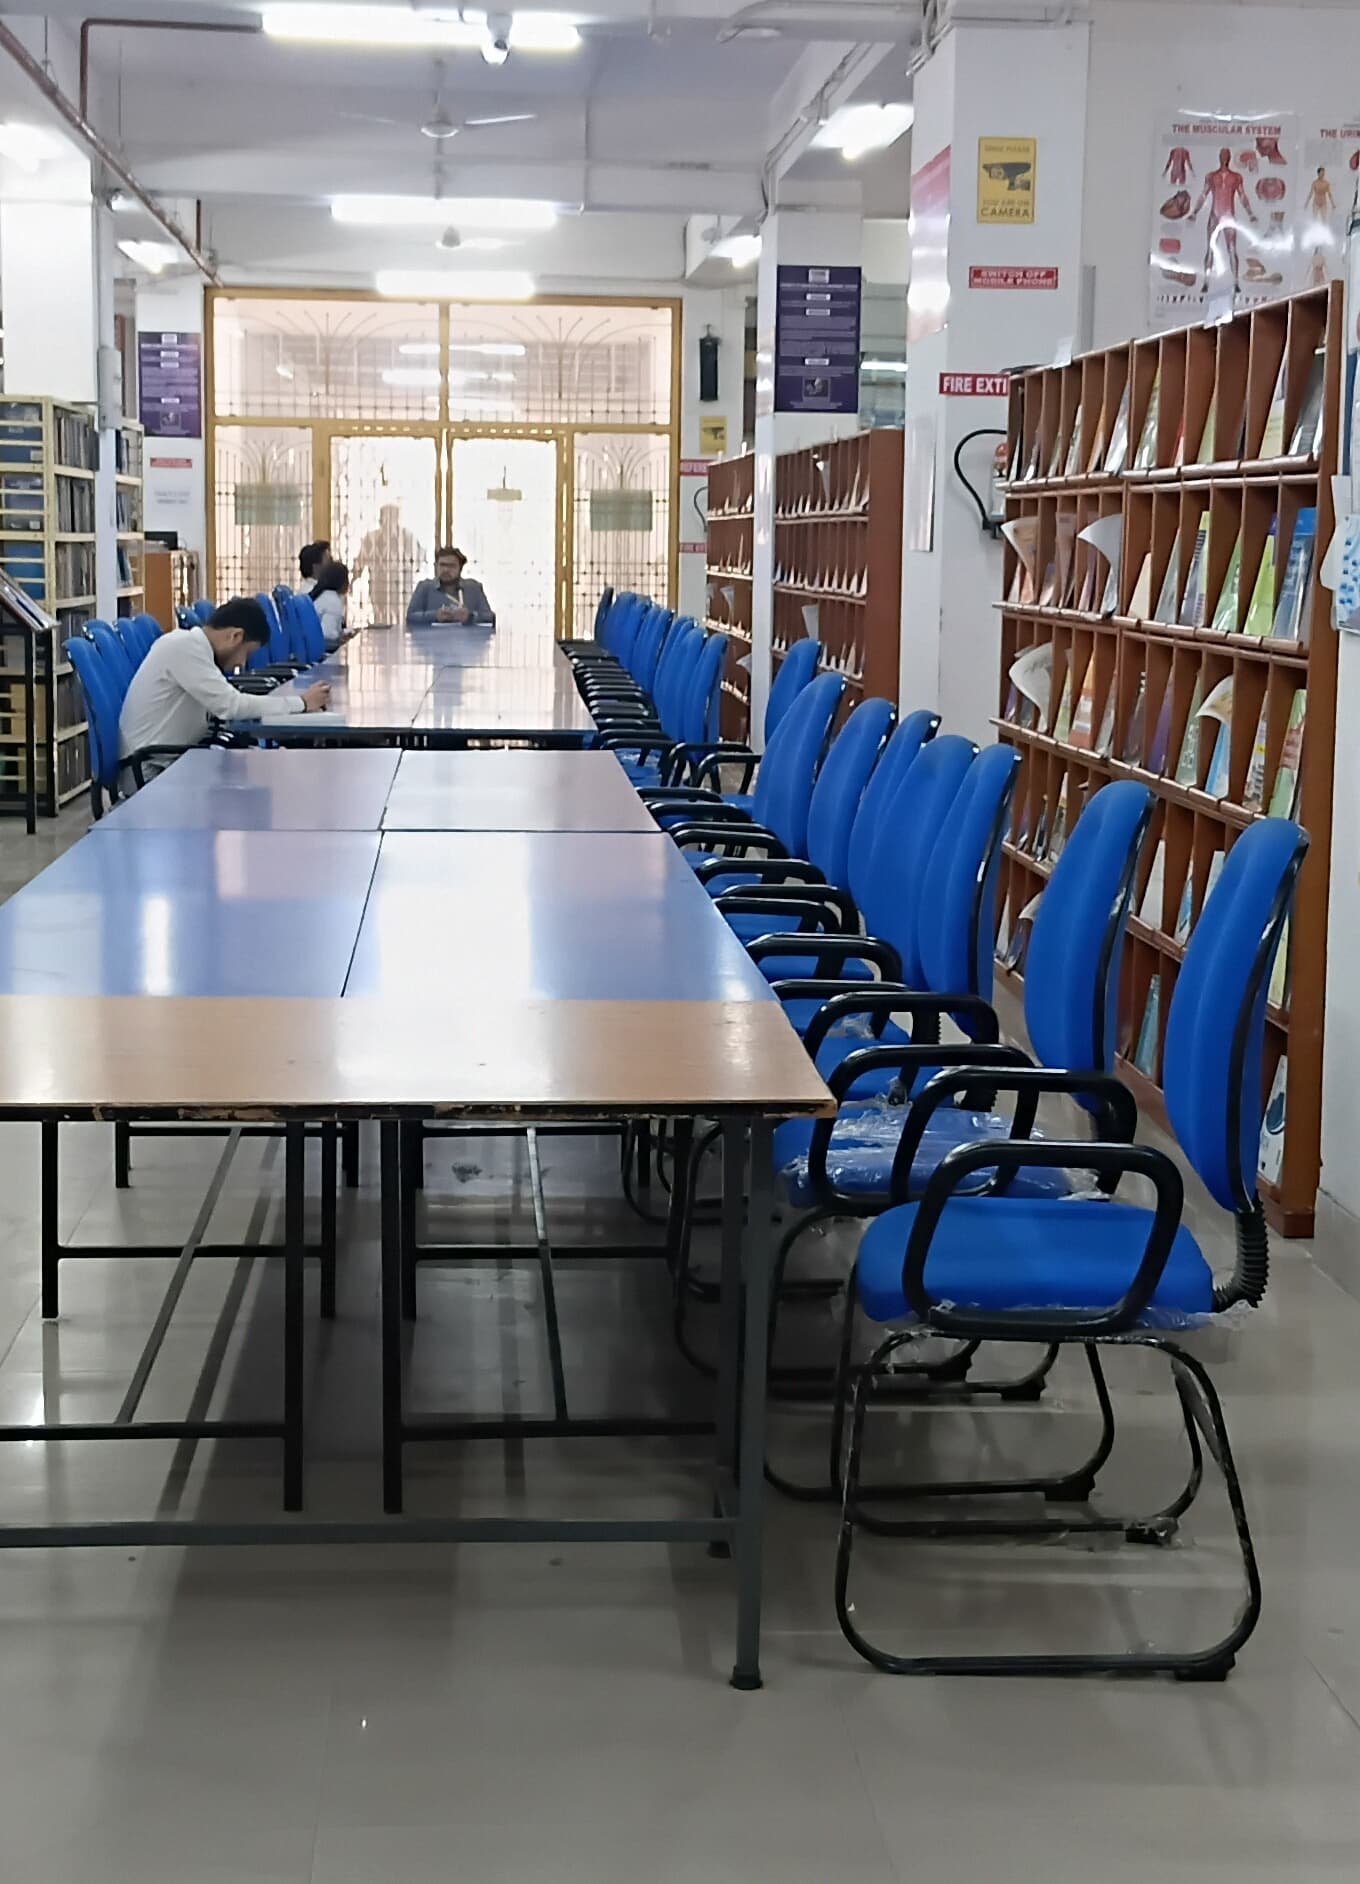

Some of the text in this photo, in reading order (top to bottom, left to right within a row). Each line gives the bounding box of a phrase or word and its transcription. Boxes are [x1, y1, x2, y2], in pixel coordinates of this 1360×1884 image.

[1172, 124, 1281, 136] THE MUSCULAR SYSTEM
[1320, 129, 1337, 138] THE
[980, 207, 1030, 217] CAMERA
[943, 376, 972, 393] FIRE
